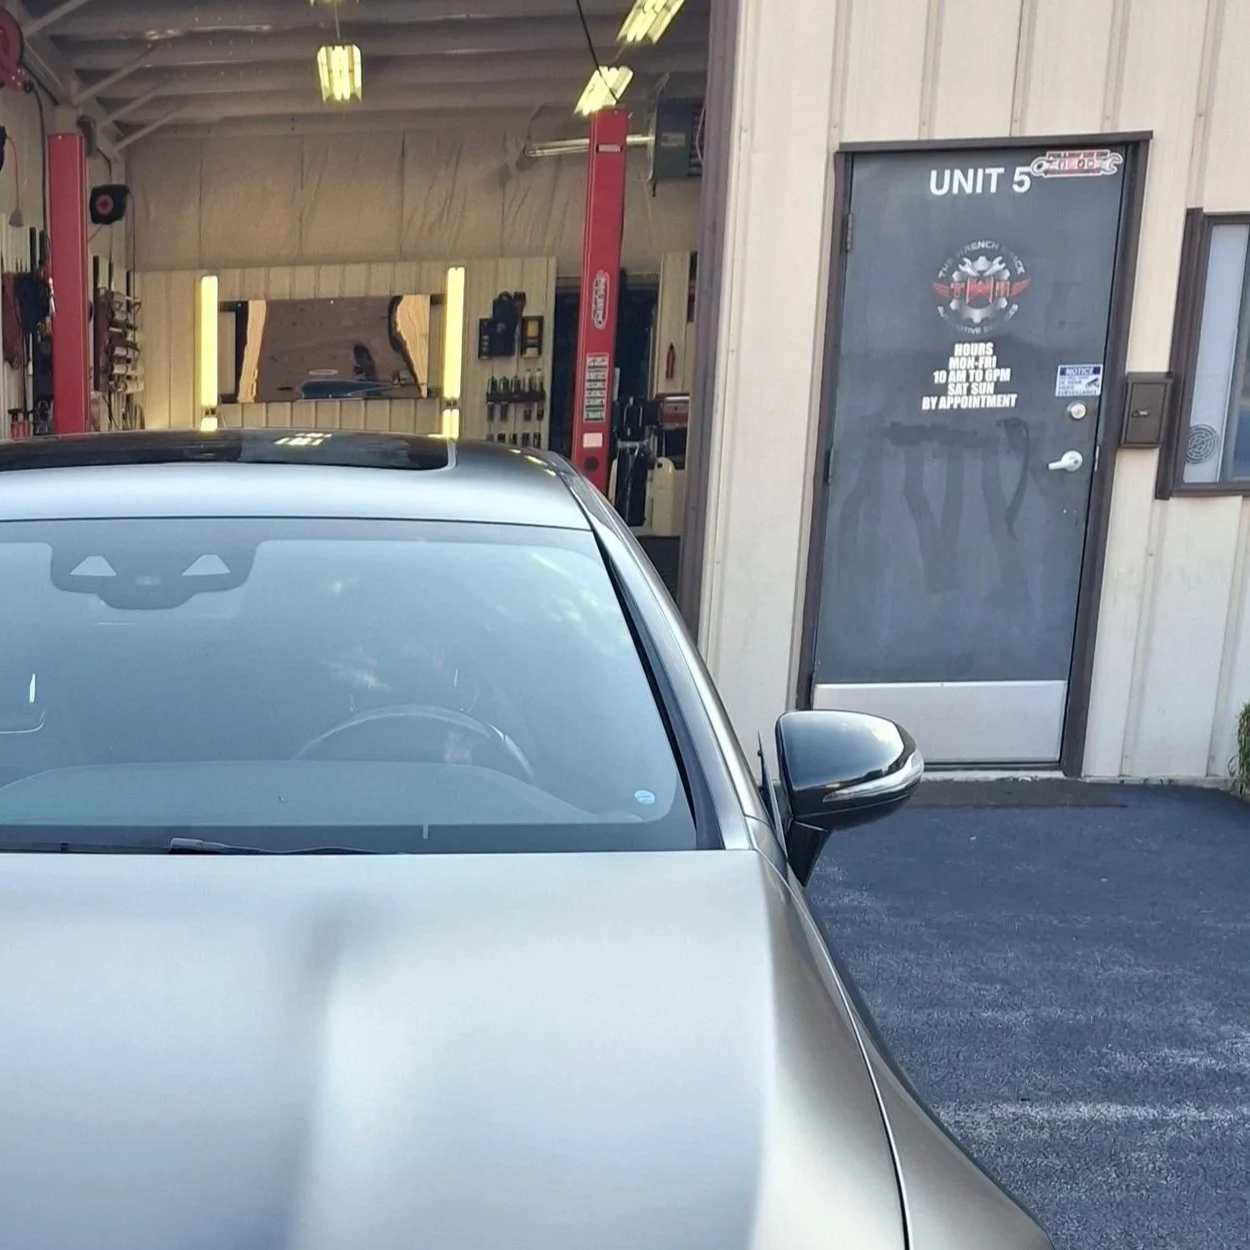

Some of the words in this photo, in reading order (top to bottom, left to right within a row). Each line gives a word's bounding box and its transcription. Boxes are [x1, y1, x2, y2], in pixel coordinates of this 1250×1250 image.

[929, 167, 1005, 195] UNIT
[1012, 166, 1032, 193] 5
[954, 342, 994, 356] HOURS
[949, 355, 997, 369] MON-FRI
[933, 370, 947, 384] 10
[948, 369, 967, 383] AM
[969, 368, 983, 382] TO
[985, 367, 1011, 382] 6PM
[948, 382, 969, 395] SAT
[971, 382, 995, 395] SUN
[922, 396, 938, 410] BY
[938, 394, 1018, 410] APPOINTMENT
